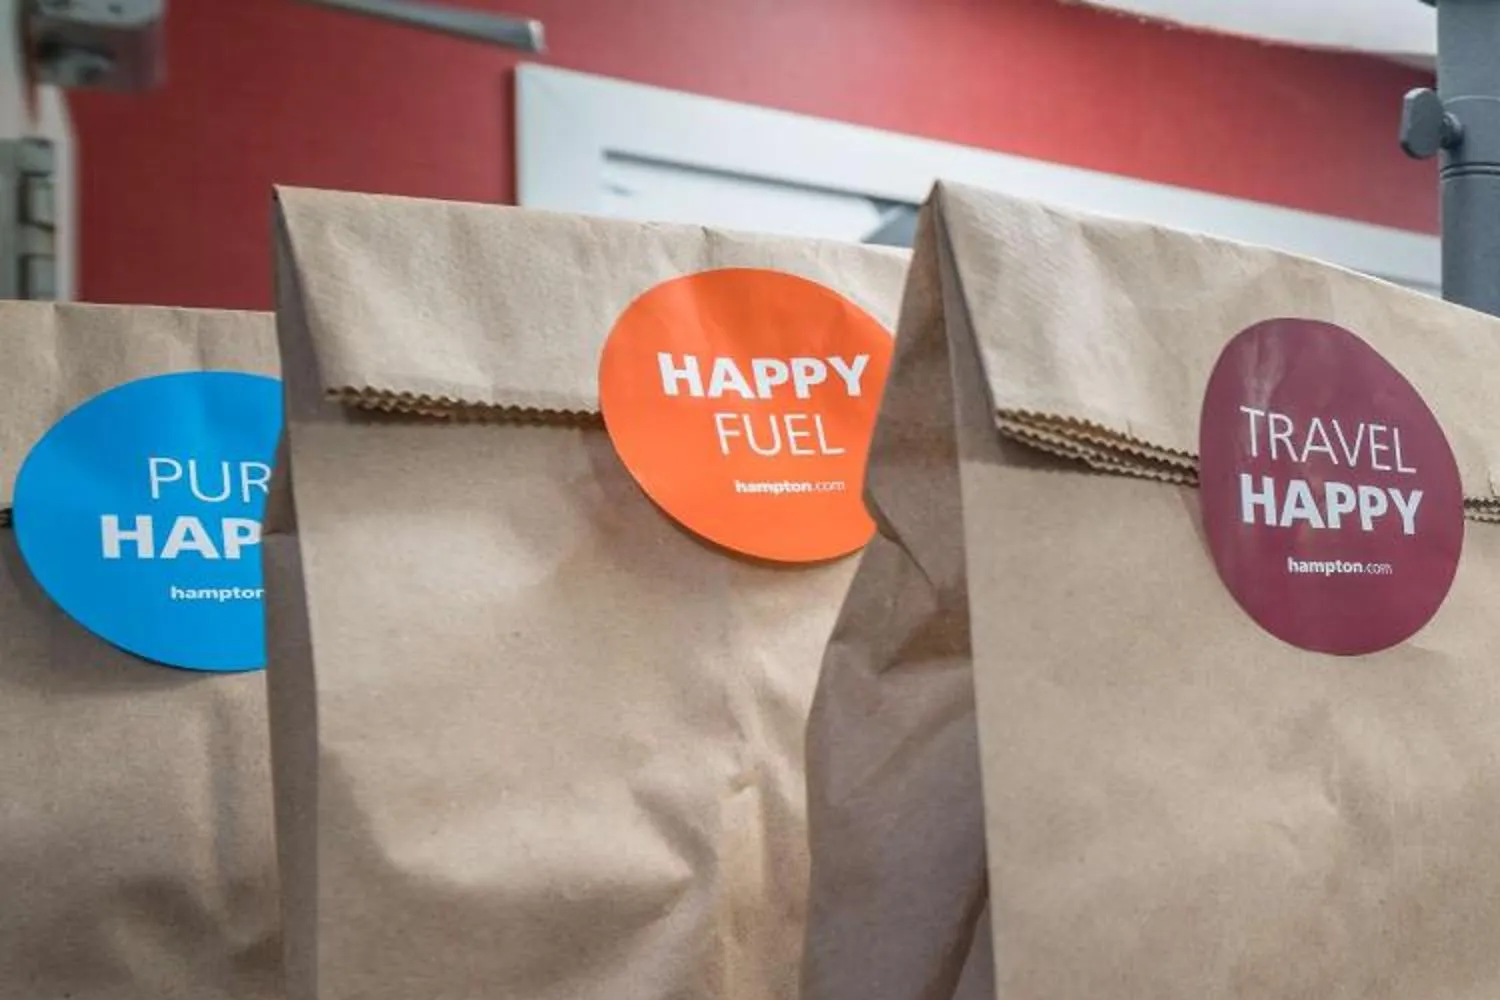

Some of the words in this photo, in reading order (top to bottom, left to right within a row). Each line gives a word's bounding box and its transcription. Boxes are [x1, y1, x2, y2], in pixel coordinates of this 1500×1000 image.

[657, 351, 870, 399] HAPPY
[713, 411, 847, 457] FUEL
[1240, 405, 1417, 474] TRAVEL
[734, 478, 846, 496] hampton.com
[1240, 473, 1424, 535] HAPPY
[1287, 556, 1393, 577] hampton.com
